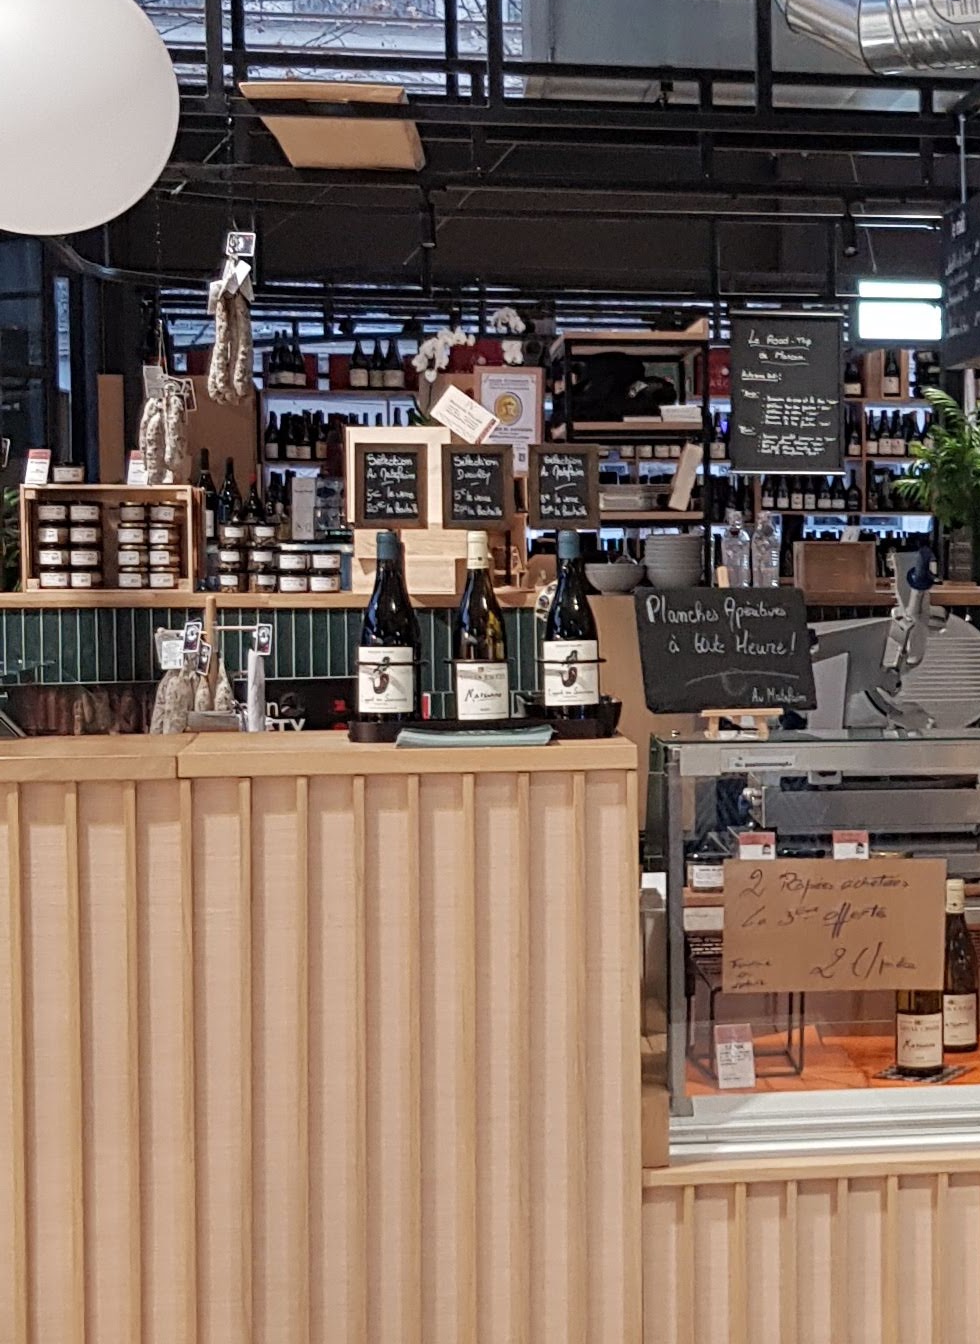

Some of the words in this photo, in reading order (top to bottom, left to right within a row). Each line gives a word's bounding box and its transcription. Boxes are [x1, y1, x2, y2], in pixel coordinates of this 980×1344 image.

[646, 594, 720, 624] Planches
[668, 634, 681, 654] à
[739, 869, 766, 898] 2
